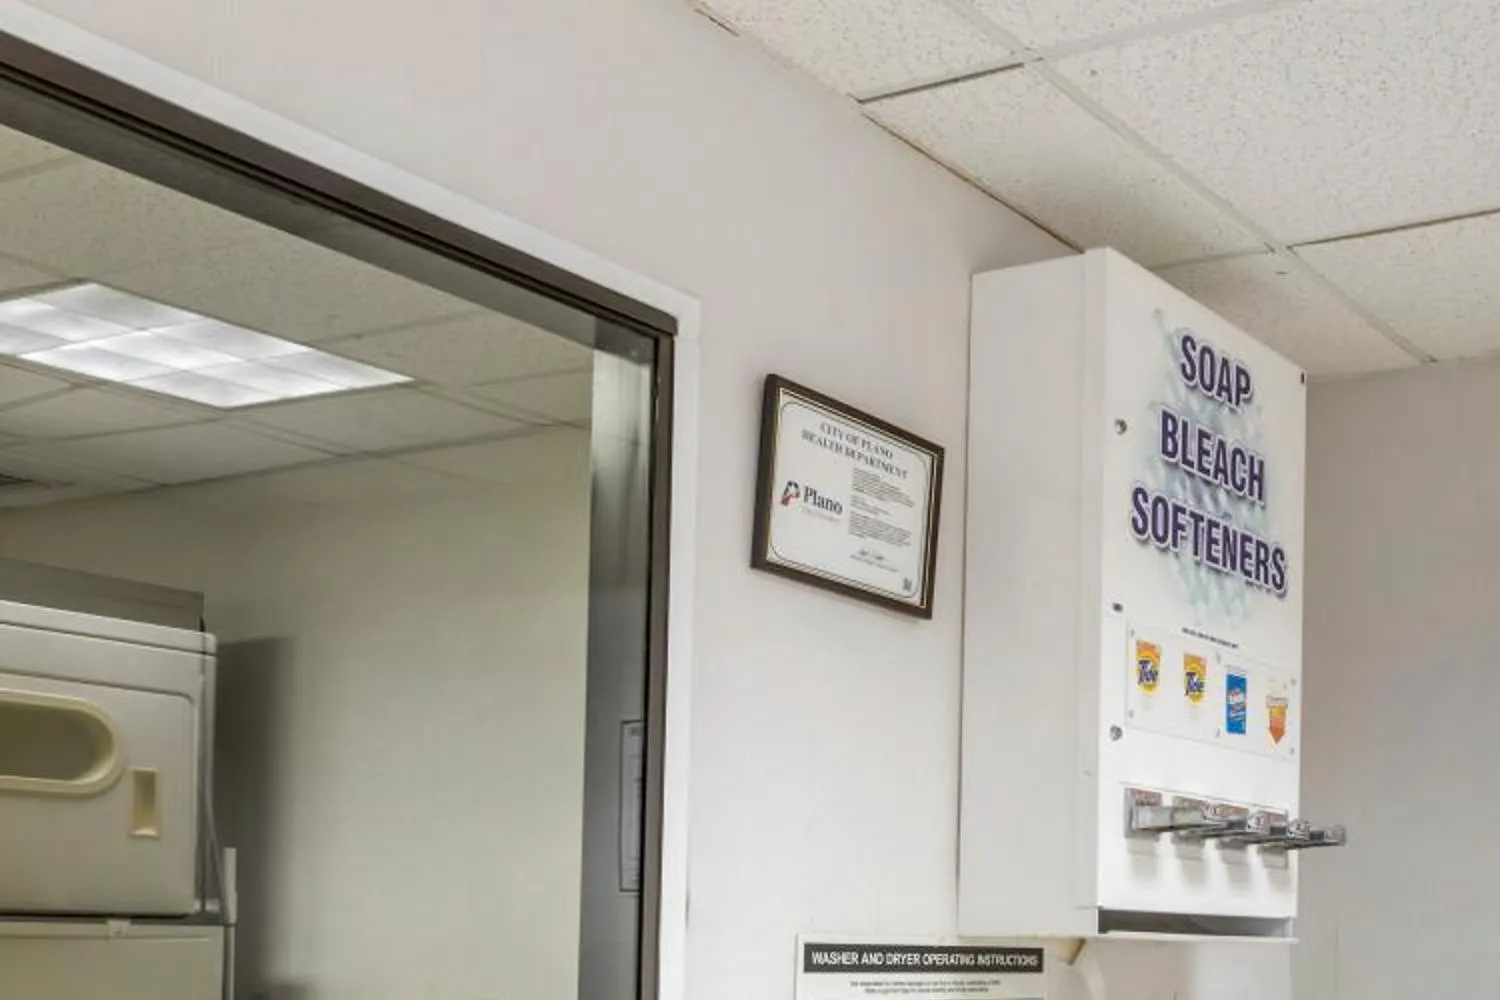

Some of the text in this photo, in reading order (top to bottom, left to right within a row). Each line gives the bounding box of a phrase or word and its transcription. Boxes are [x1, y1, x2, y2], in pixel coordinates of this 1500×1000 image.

[1181, 334, 1251, 406] SOAP
[801, 428, 908, 480] HEALTH DEPARTMENT
[820, 421, 893, 460] CITY OF PLANO
[1161, 409, 1265, 501] BLEACH
[803, 485, 843, 515] Plano
[1131, 486, 1286, 592] SOFTENERS
[811, 951, 1039, 967] WASHER AND DRYER OPERATING INSTRUCTIONS
